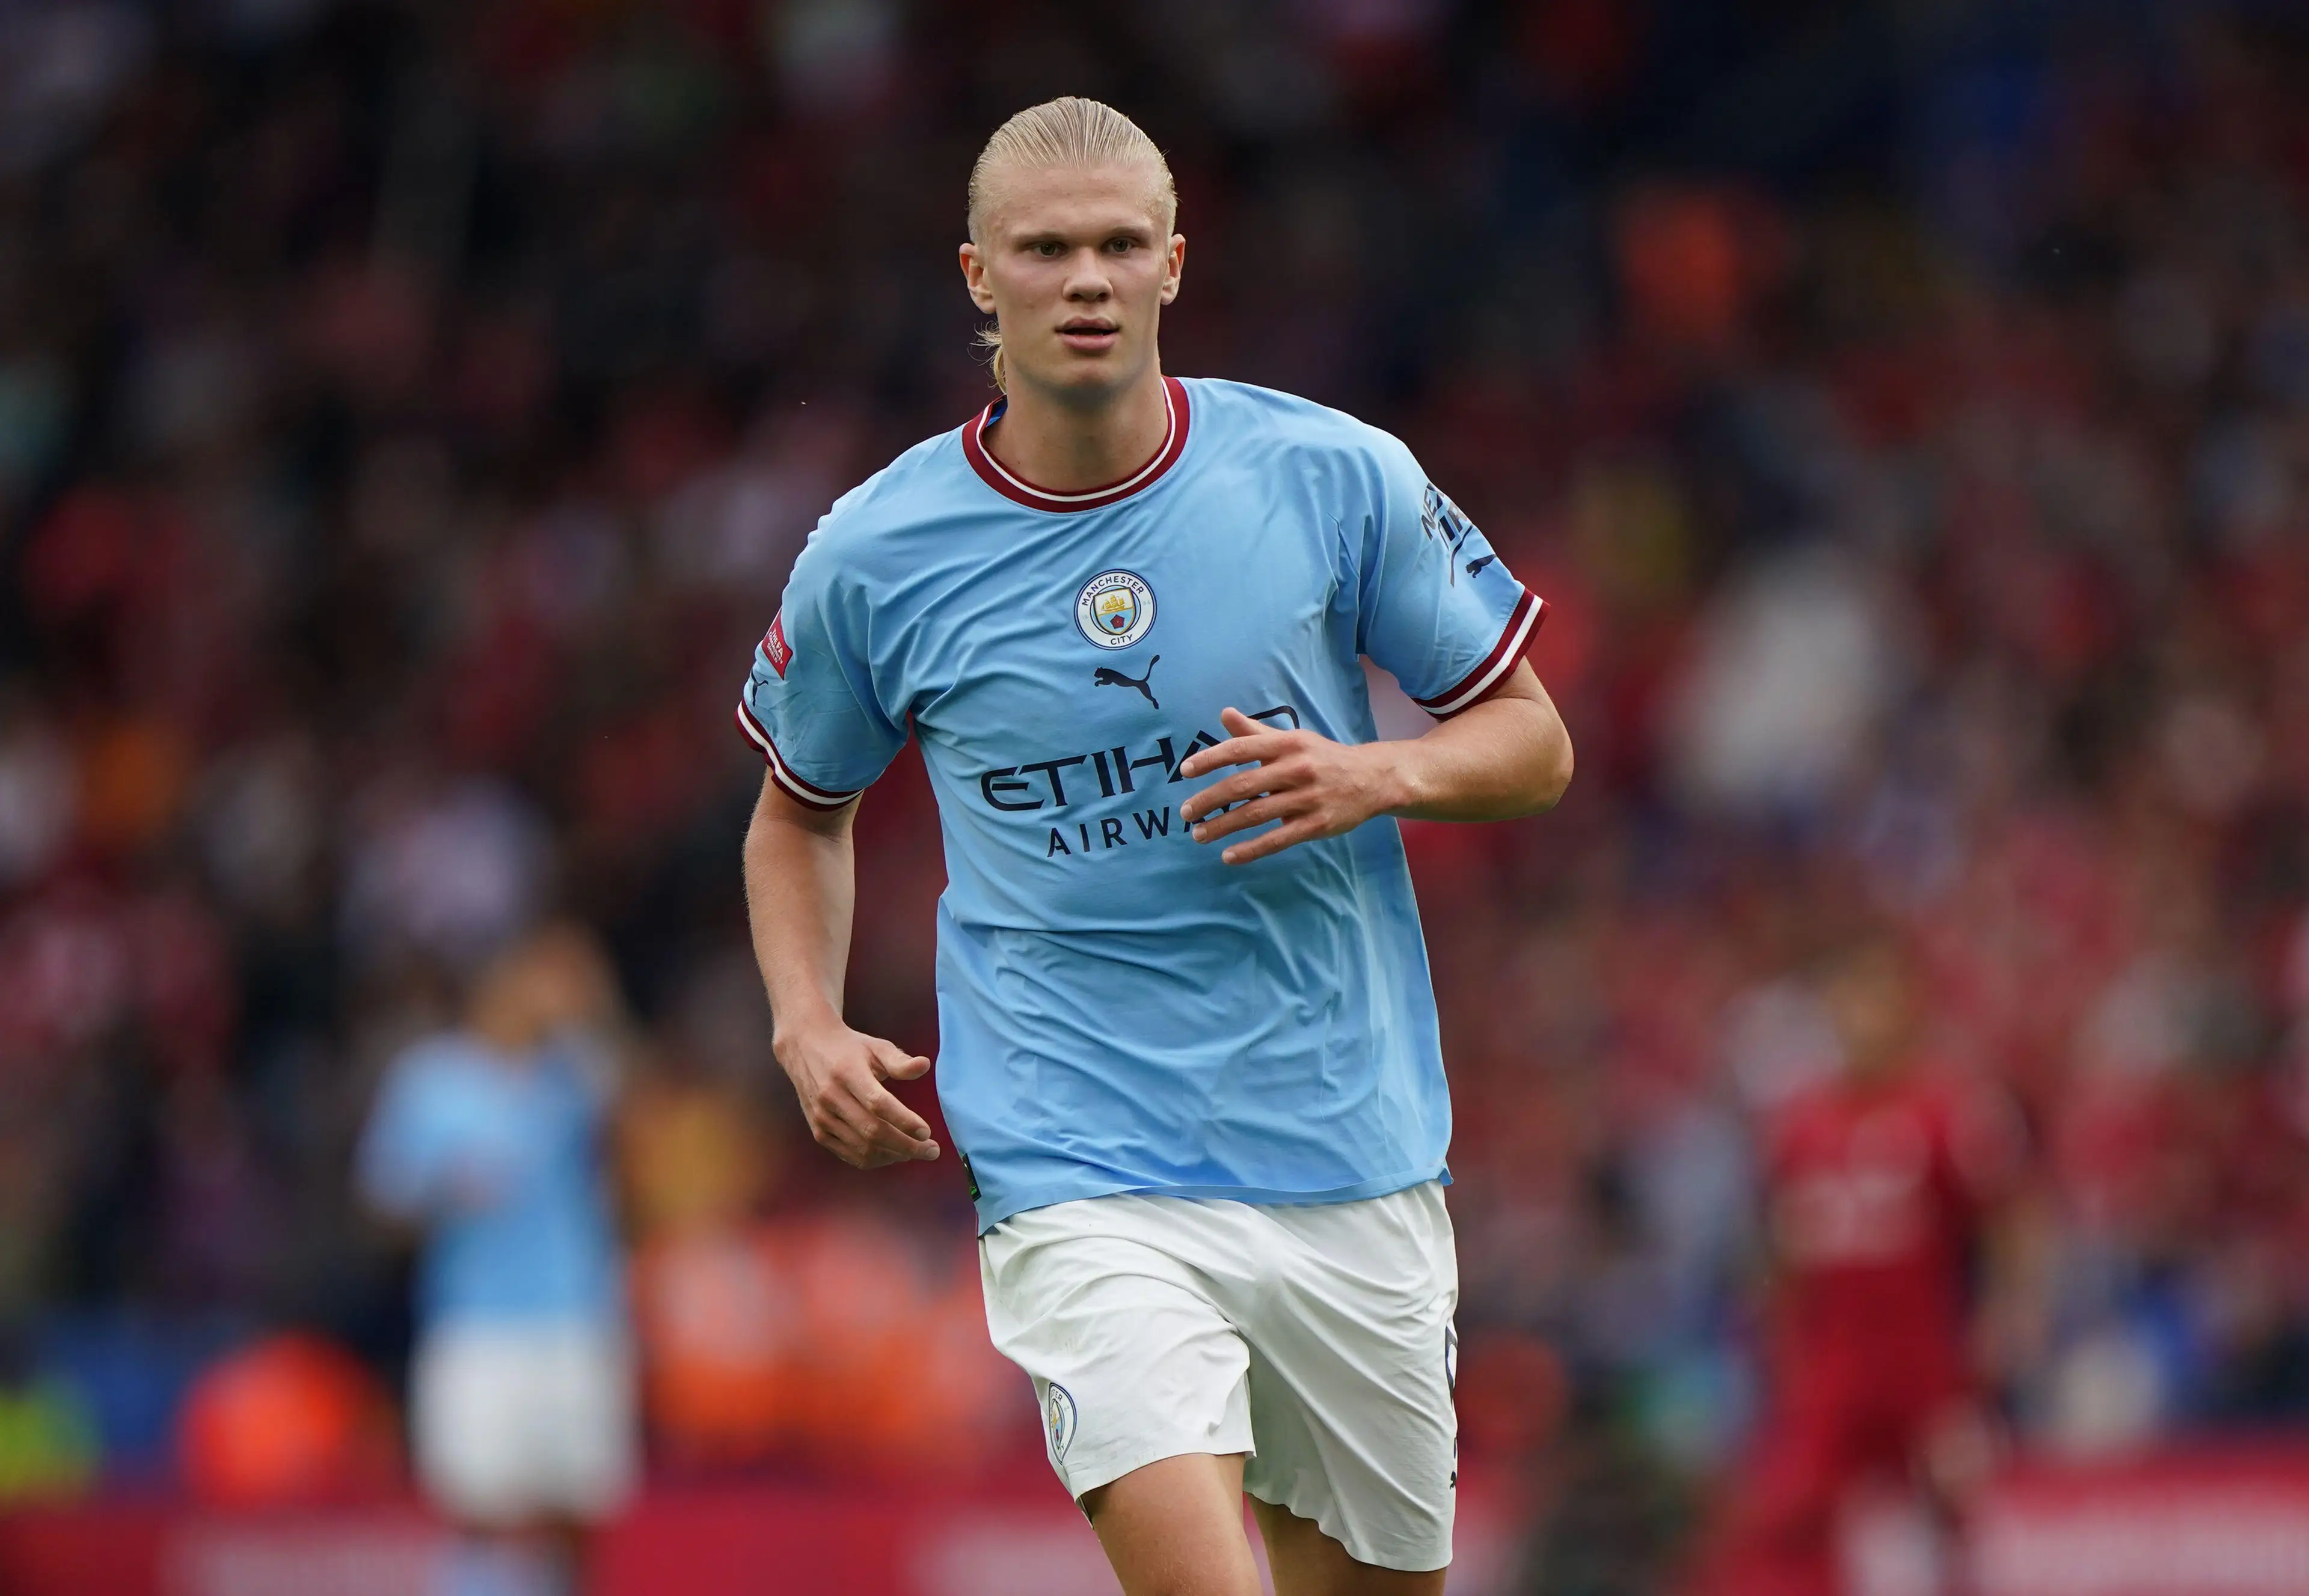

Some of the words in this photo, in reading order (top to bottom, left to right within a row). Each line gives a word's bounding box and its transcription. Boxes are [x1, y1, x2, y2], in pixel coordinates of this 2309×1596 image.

[1081, 575, 1144, 606] MANCHESTER
[776, 641, 783, 658] FA
[1110, 634, 1133, 645] CITY
[1047, 795, 1263, 858] AIRW
